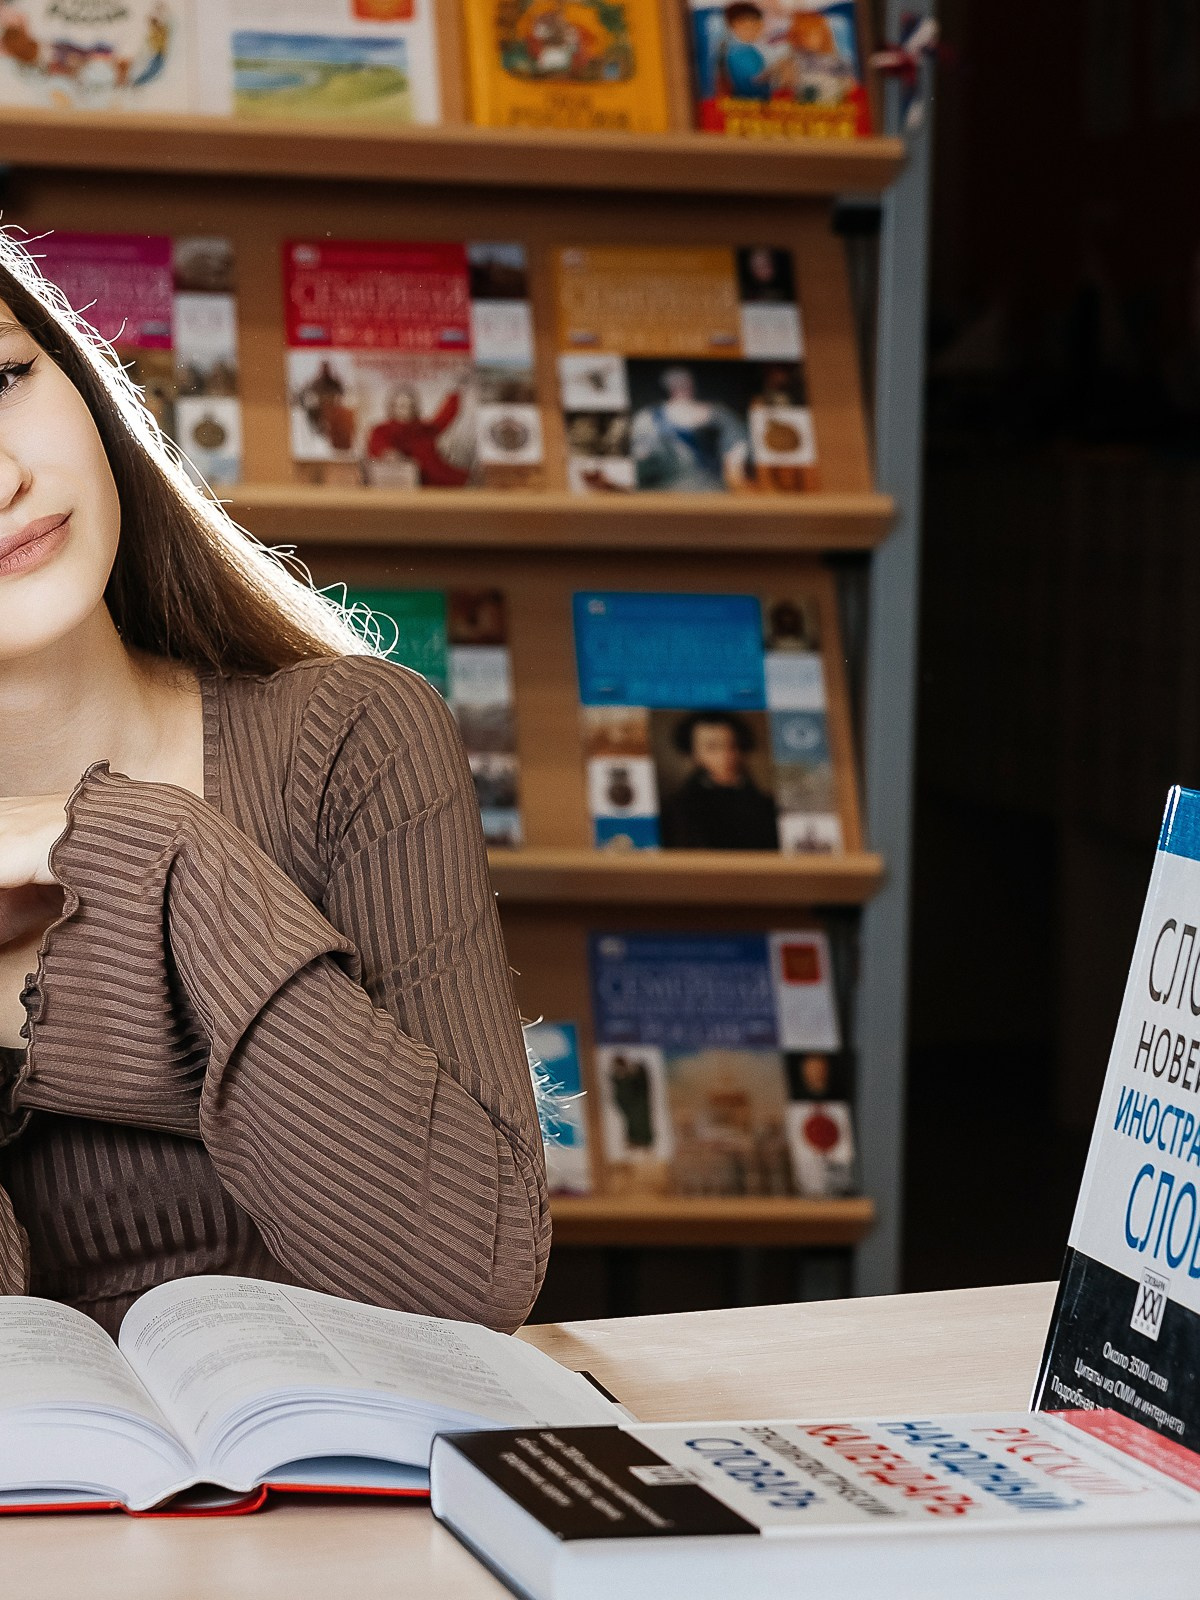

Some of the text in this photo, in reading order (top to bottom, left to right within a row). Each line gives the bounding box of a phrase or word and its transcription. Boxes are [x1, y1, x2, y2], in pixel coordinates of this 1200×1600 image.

[1134, 1020, 1200, 1094] НОВЕ
[1074, 1356, 1105, 1387] Цитаты
[1102, 1377, 1115, 1394] из
[1114, 1380, 1138, 1406] СМИ
[1140, 1398, 1186, 1436] интернета
[1102, 1341, 1130, 1370] Около
[1148, 1370, 1169, 1393] слов
[684, 1437, 826, 1510] СЛОВАРЬ
[797, 1423, 982, 1518] КАЛЕНДАРЬ
[877, 1420, 1087, 1511] НАРОДНЫЙ
[971, 1426, 1150, 1497] РУССКИЙ
